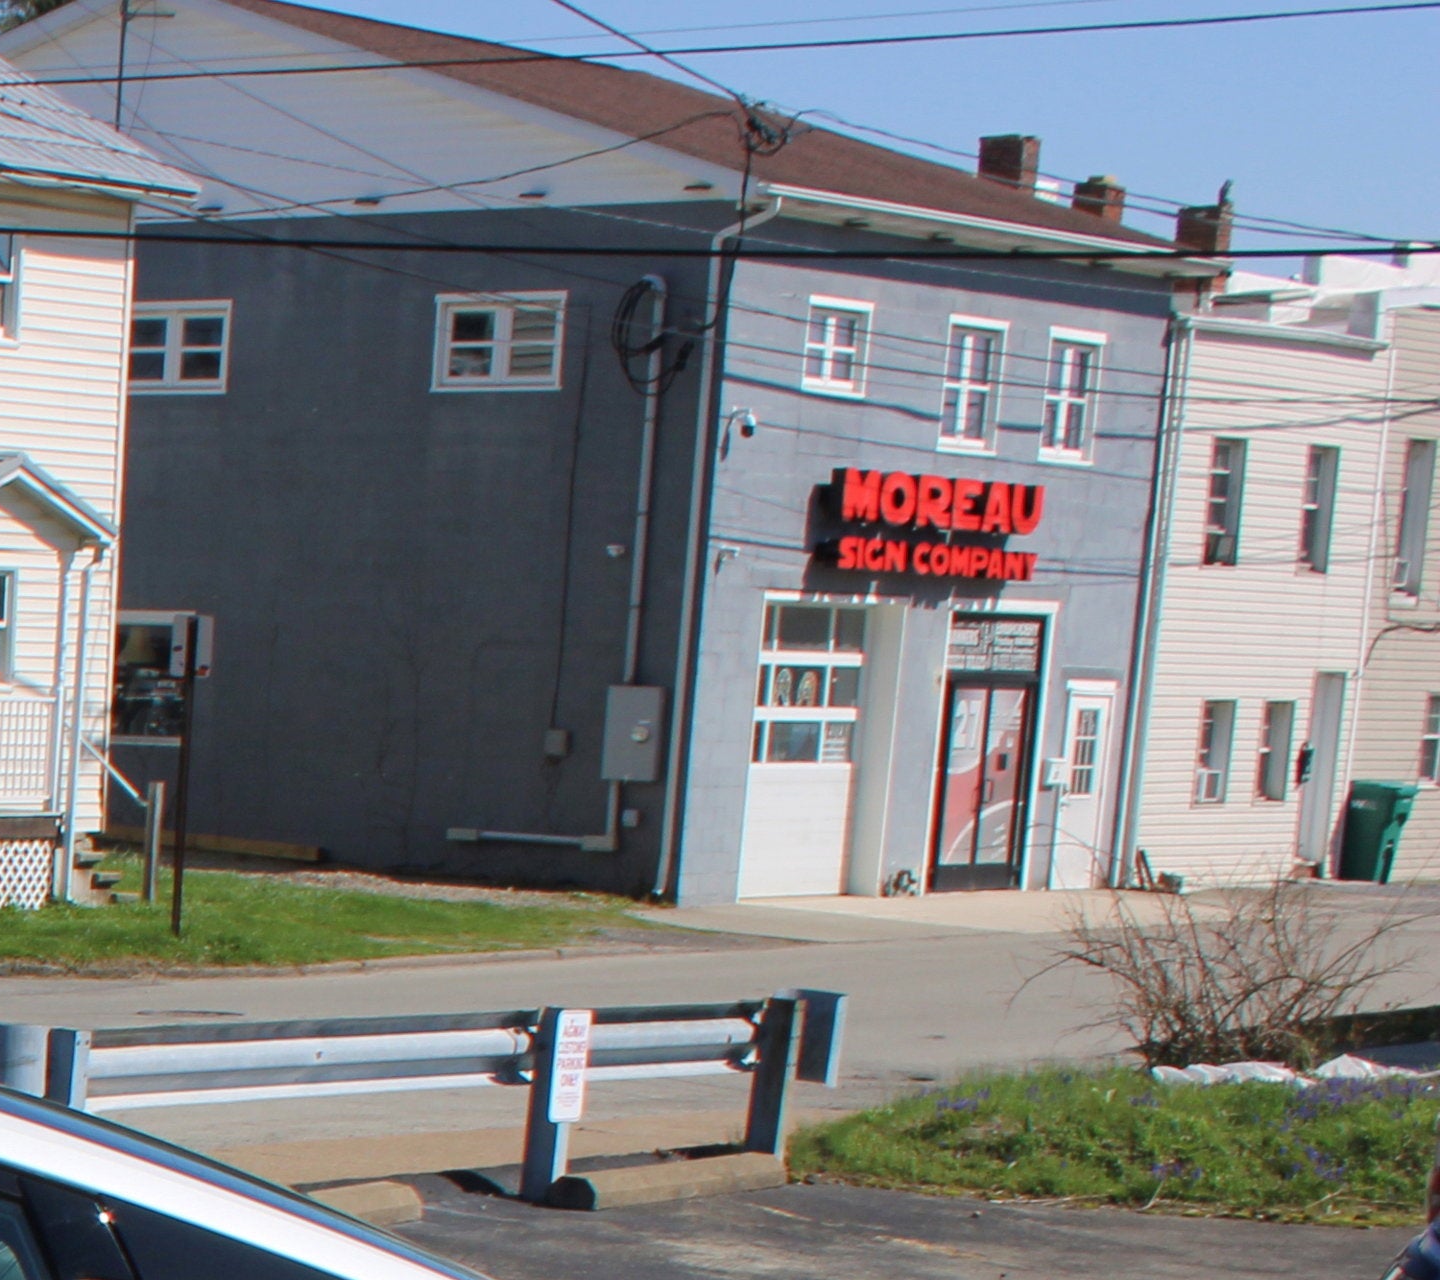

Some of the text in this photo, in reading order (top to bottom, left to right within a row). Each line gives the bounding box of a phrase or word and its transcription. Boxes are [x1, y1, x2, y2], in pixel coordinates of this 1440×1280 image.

[842, 467, 1046, 536] MOREAU
[837, 536, 1040, 582] SIGN COMPANY
